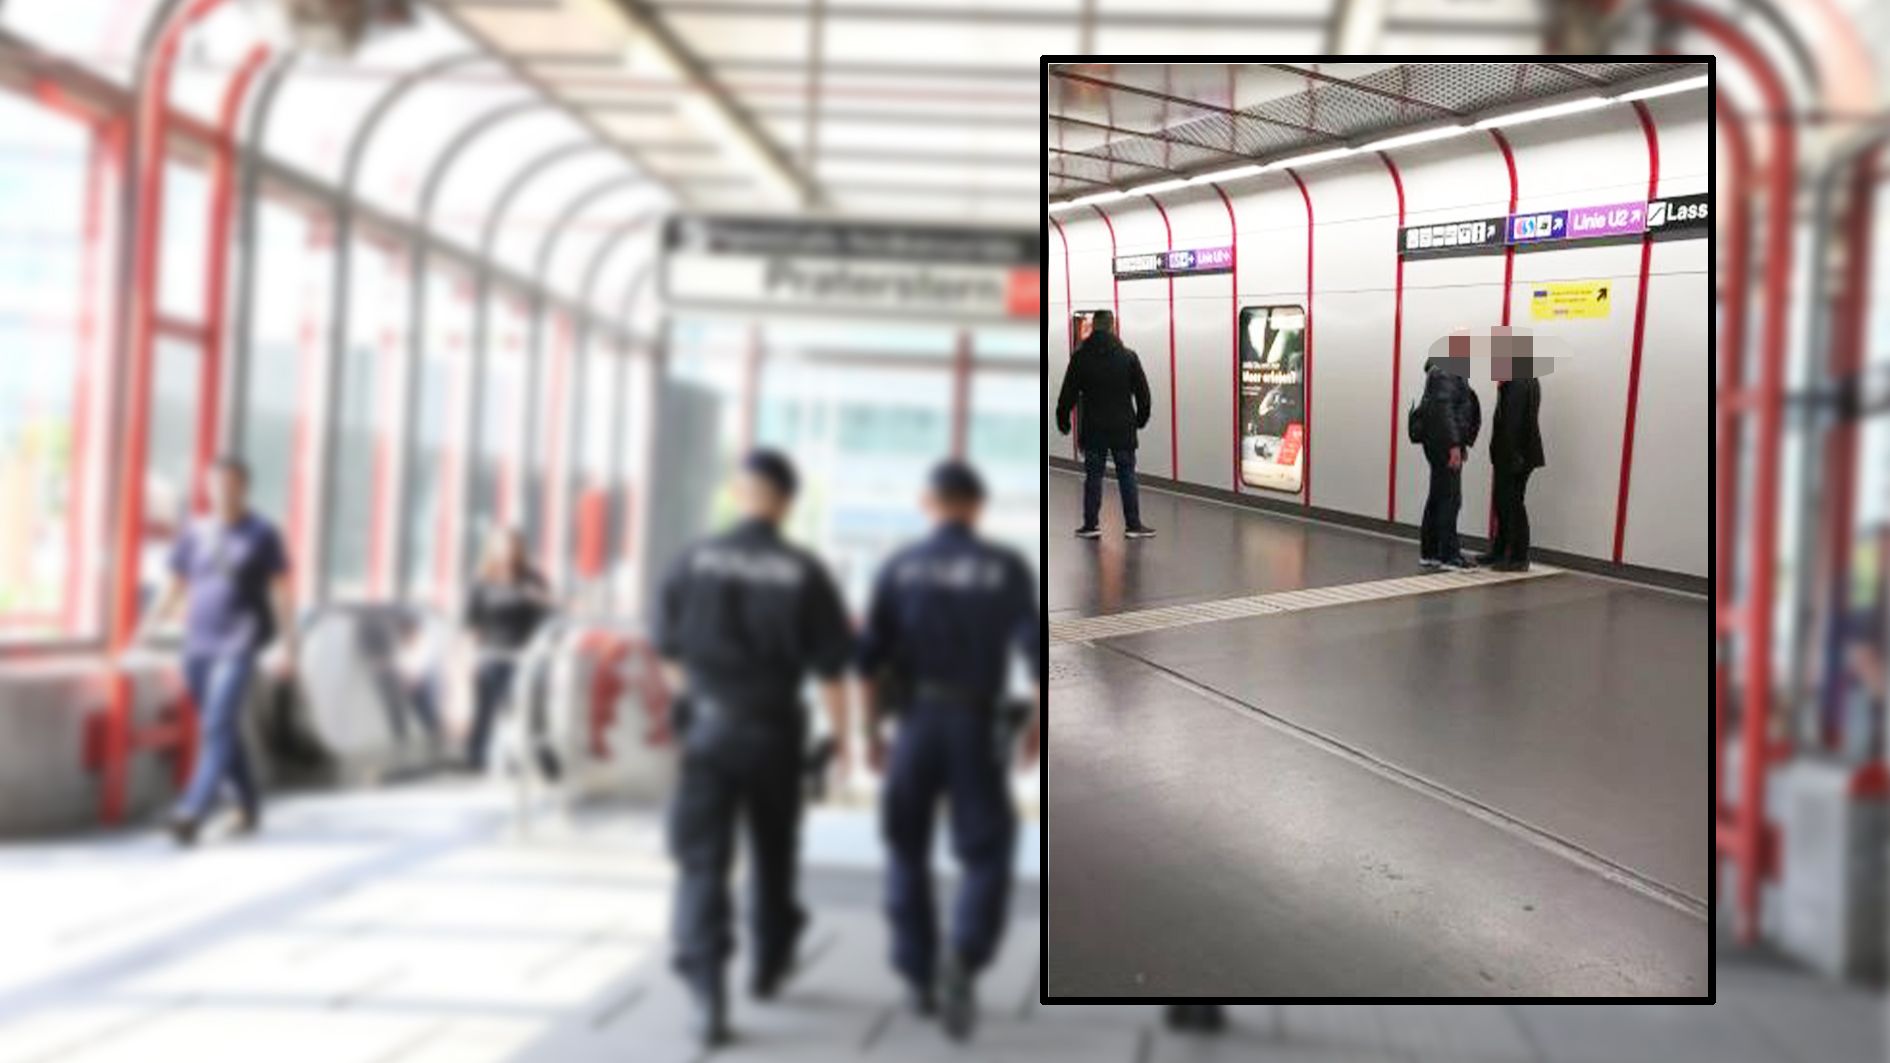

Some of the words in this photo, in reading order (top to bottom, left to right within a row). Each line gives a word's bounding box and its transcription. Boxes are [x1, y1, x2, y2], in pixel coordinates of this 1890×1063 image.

[1573, 212, 1605, 231] Linie
[1608, 209, 1627, 227] U2
[1667, 203, 1709, 221] Lass
